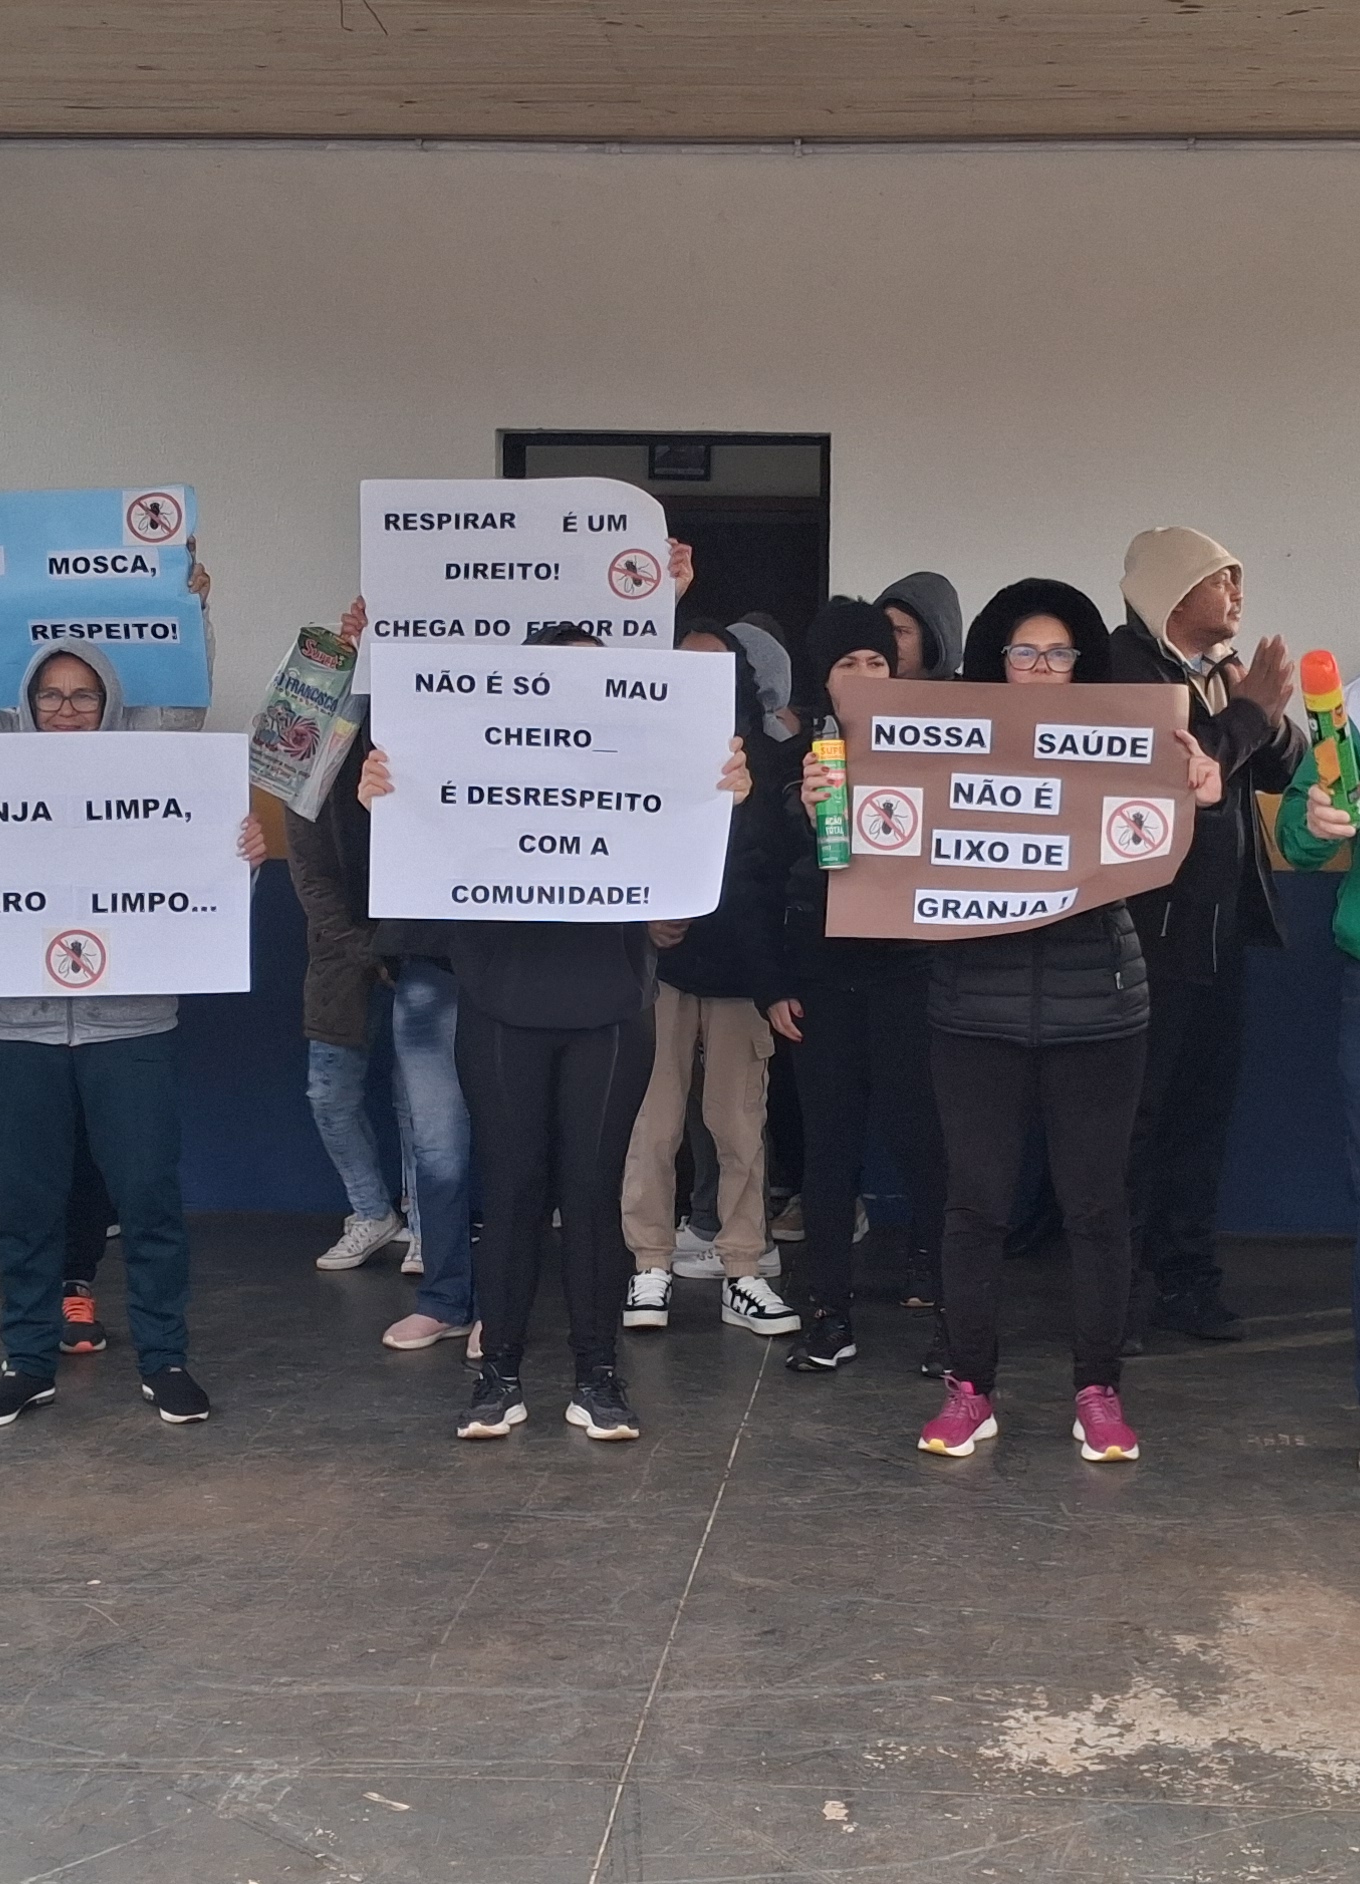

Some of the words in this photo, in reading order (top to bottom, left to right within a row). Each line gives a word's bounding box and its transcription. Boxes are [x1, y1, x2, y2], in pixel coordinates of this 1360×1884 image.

[384, 512, 516, 531] RESPIRAR
[563, 511, 578, 533] É
[588, 514, 627, 532] UM
[48, 554, 157, 577] MOSCA,
[445, 562, 560, 580] DIREITO!
[31, 623, 177, 641] RESPEITO!
[374, 619, 465, 637] CHEGA
[475, 619, 511, 637] DO
[623, 619, 657, 637] DA
[415, 671, 476, 694] NÃO
[486, 671, 503, 694] É
[513, 672, 551, 696] SÓ
[605, 678, 668, 702] MAU
[874, 723, 987, 750] NOSSA
[1036, 729, 1150, 759] SAÚDE
[440, 781, 457, 804] É
[467, 786, 662, 813] DESRESPEITO
[952, 778, 1023, 809] NÃO
[1034, 783, 1053, 809] É
[86, 798, 192, 822] LIMPA,
[518, 834, 581, 854] COM
[591, 837, 609, 856] A
[934, 837, 1011, 865] LIXO
[1022, 843, 1063, 866] DE
[92, 892, 217, 913] LIMPO...
[451, 885, 650, 905] COMUNIDADE!
[917, 897, 1049, 920] GRANJA
